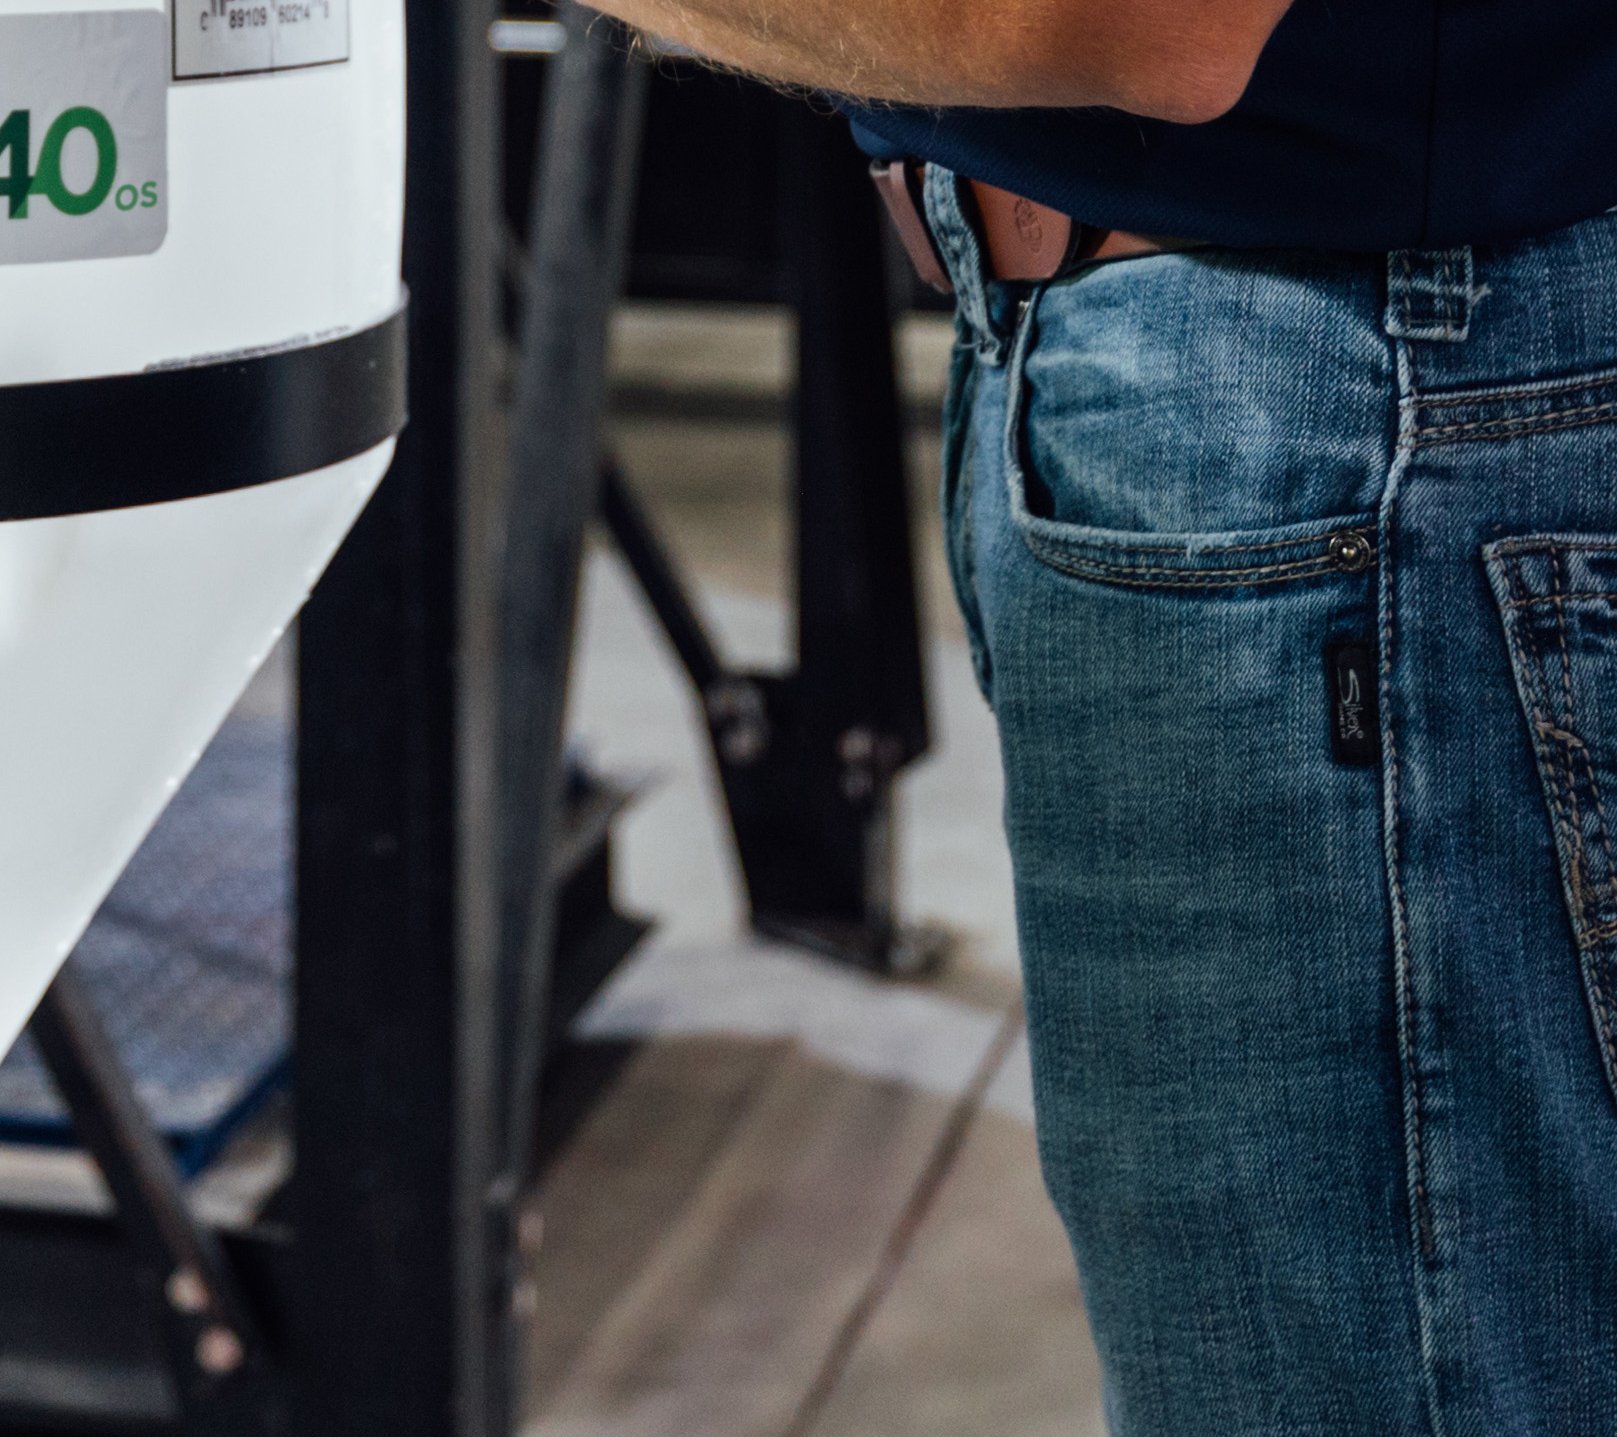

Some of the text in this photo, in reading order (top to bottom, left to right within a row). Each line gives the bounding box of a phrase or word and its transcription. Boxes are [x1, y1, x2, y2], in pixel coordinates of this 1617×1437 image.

[229, 7, 268, 30] 89109
[278, 4, 310, 24] 60214
[114, 182, 158, 212] OS
